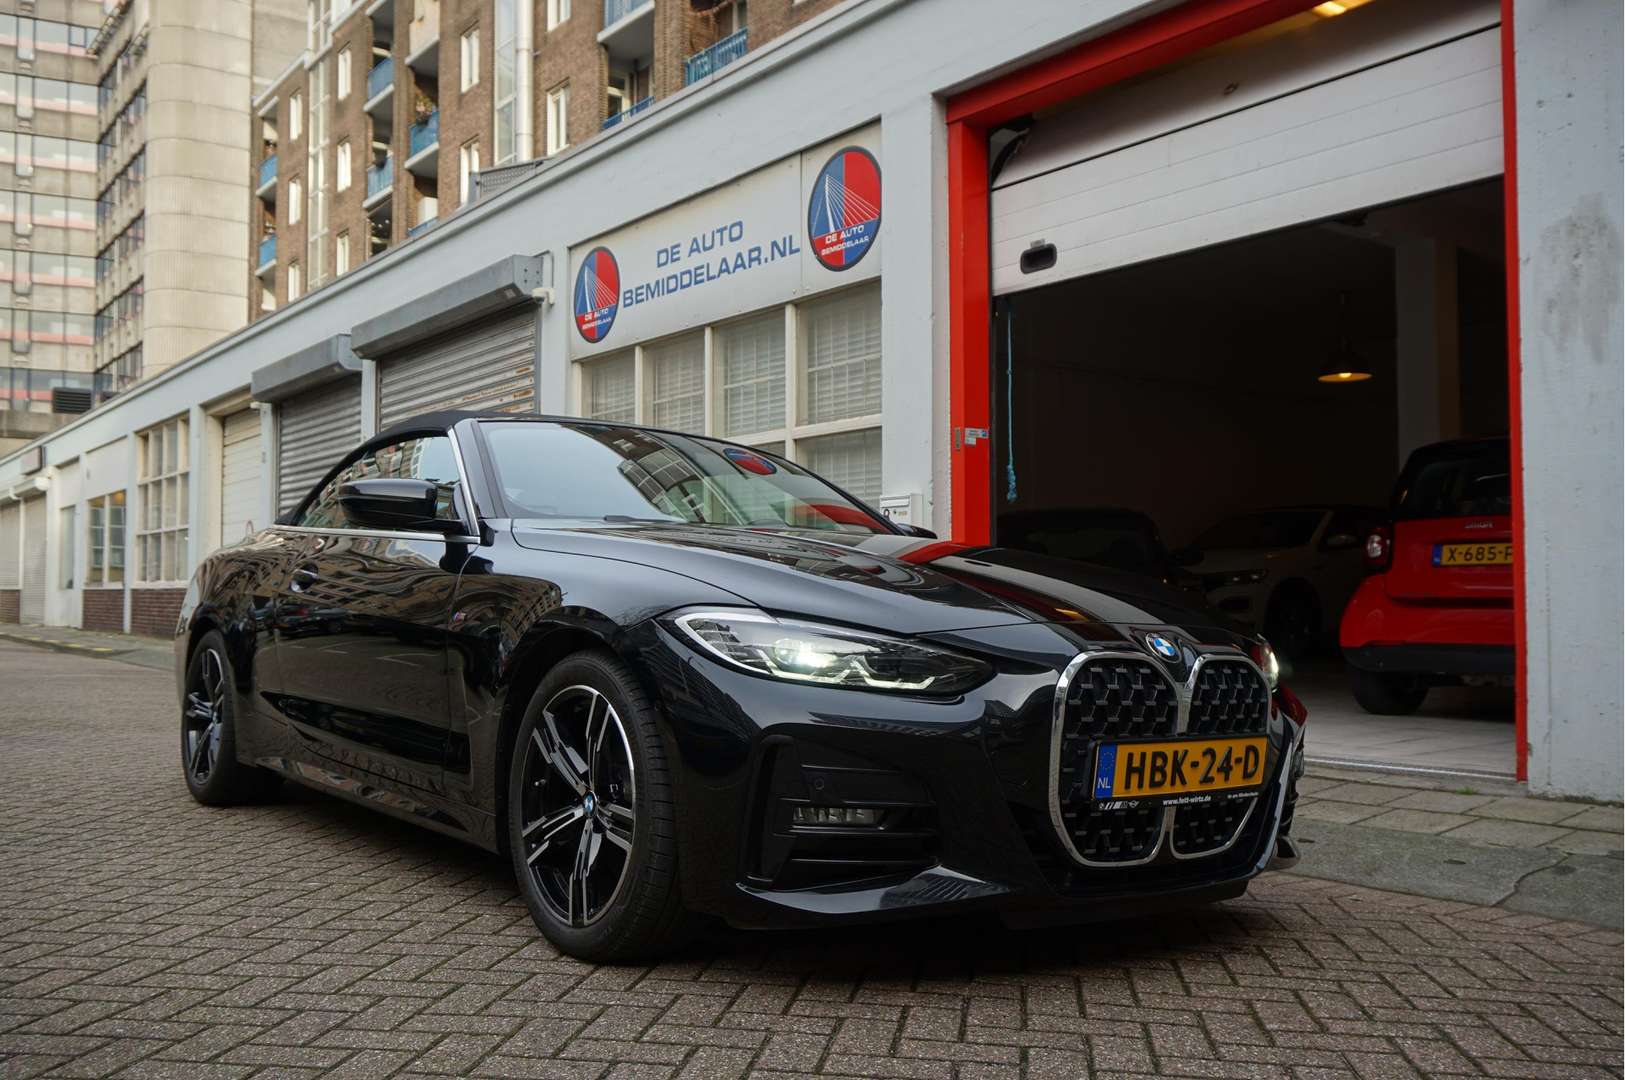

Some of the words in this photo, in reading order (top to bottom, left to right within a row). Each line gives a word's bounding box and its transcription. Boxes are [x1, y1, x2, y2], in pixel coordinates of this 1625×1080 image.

[656, 241, 681, 268] DE
[687, 220, 744, 257] AUTO
[825, 233, 838, 244] DE
[840, 224, 865, 239] AUTO
[622, 234, 801, 309] BEMIDDELAAR.NL
[1097, 777, 1111, 789] NL
[1124, 744, 1260, 790] HBK-24-D
